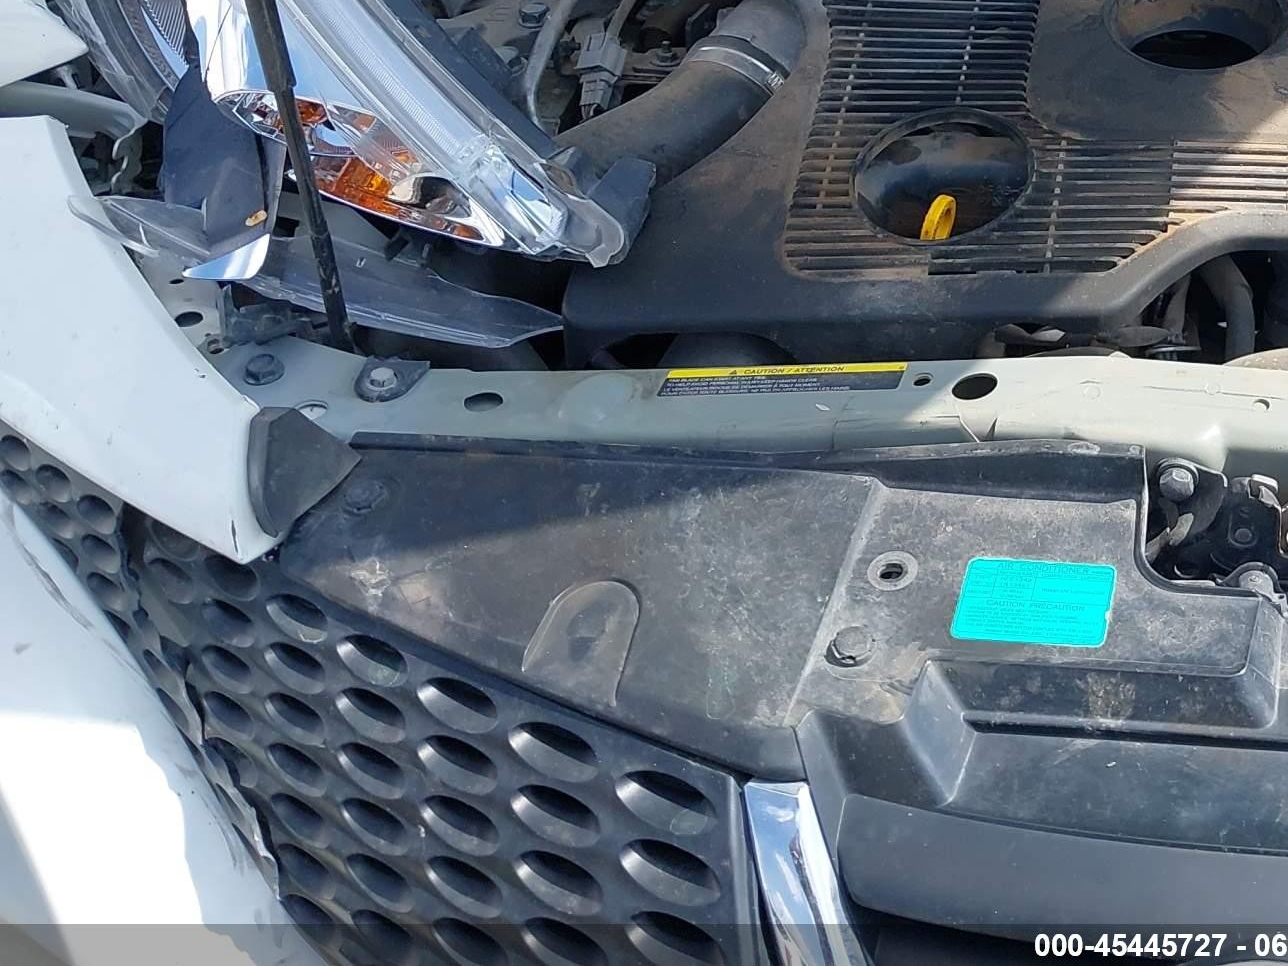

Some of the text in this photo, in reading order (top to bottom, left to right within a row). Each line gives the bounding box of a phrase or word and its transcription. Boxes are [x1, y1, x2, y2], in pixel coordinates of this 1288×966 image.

[998, 562, 1014, 571] AIR
[1020, 563, 1089, 574] CONDITIONER
[986, 599, 1026, 609] CAUTION
